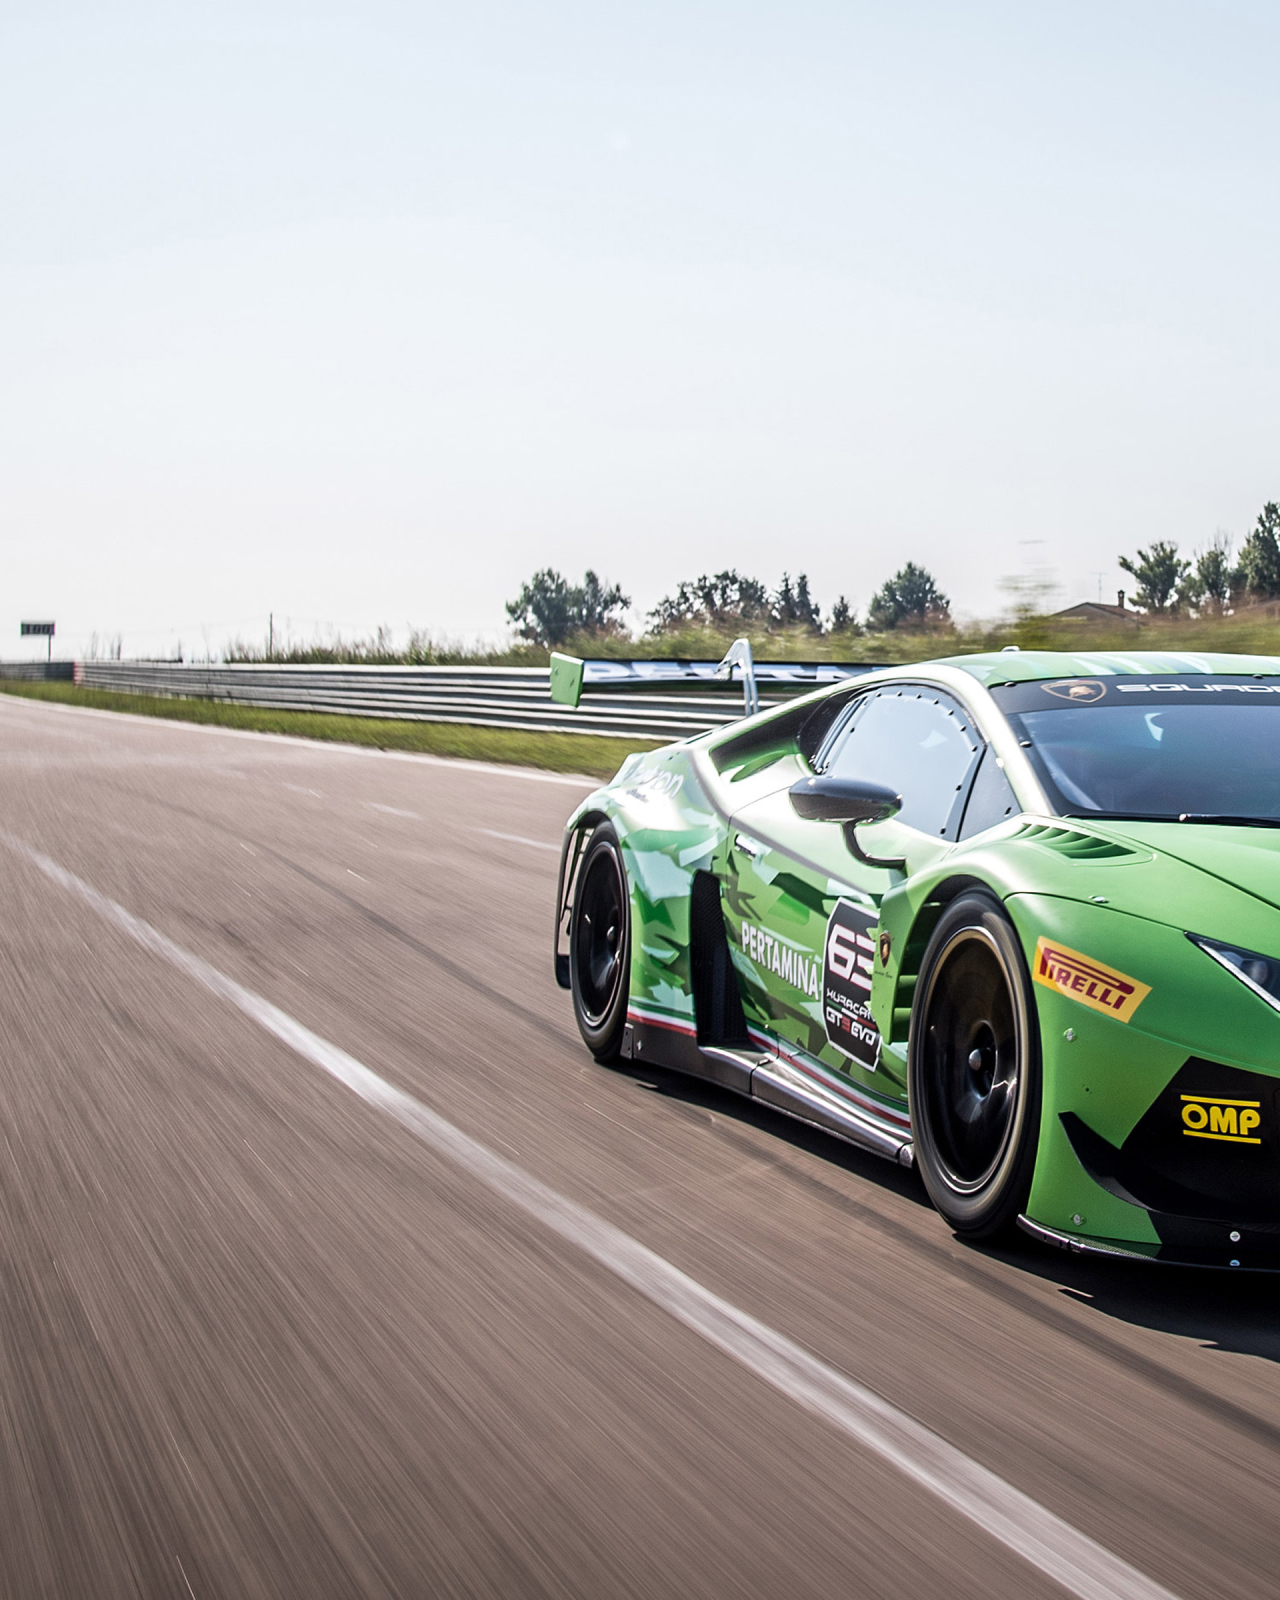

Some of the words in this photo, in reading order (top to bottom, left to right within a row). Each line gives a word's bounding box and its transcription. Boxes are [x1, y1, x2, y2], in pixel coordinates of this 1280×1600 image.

[741, 920, 819, 1001] PERTAMINA
[828, 923, 876, 991] 63
[1039, 947, 1135, 1010] PIRELLI
[826, 1006, 851, 1033] GT3
[850, 1021, 877, 1046] EVO
[1181, 1103, 1261, 1136] OMP
